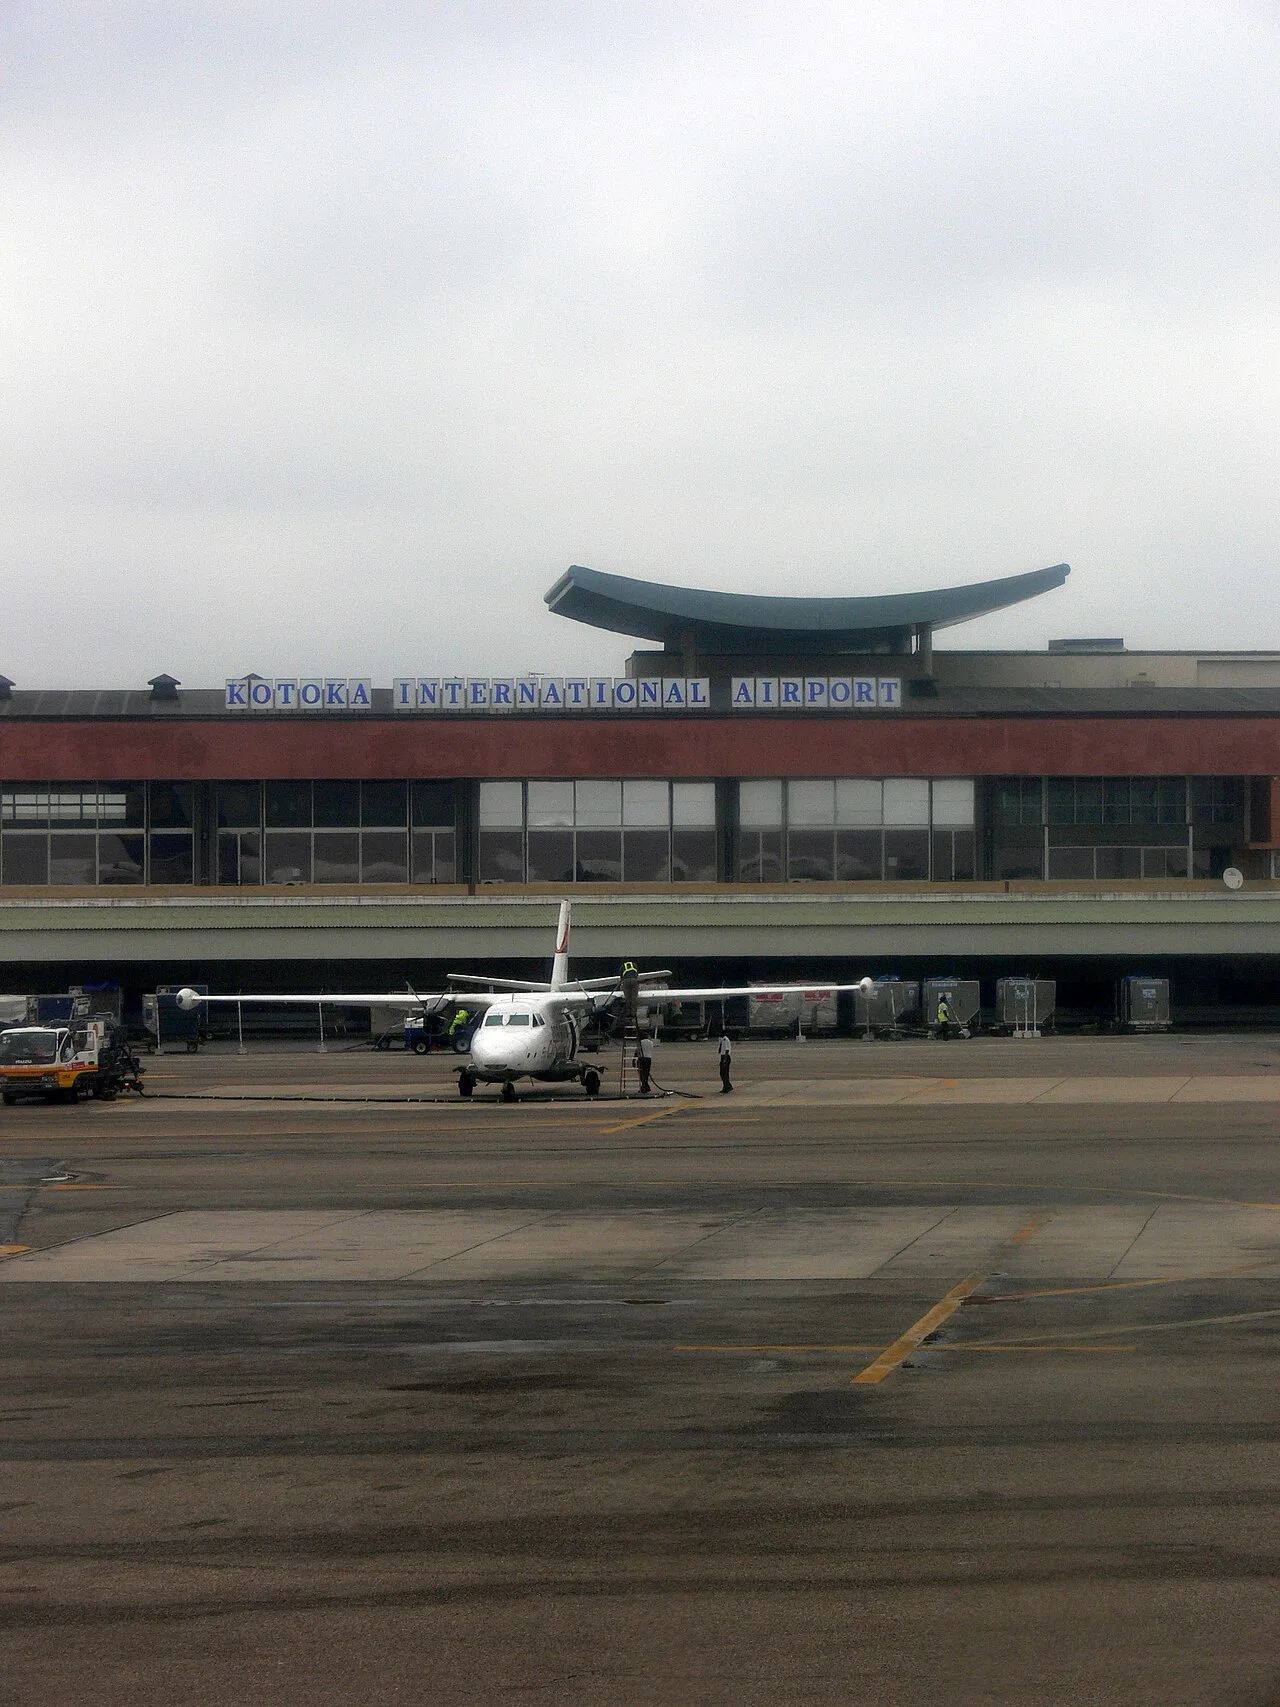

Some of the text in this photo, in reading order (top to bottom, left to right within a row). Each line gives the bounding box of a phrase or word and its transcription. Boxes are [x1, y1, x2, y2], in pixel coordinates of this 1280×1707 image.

[227, 681, 899, 705] KOTOKA INTERNATIONAL AIRPORT
